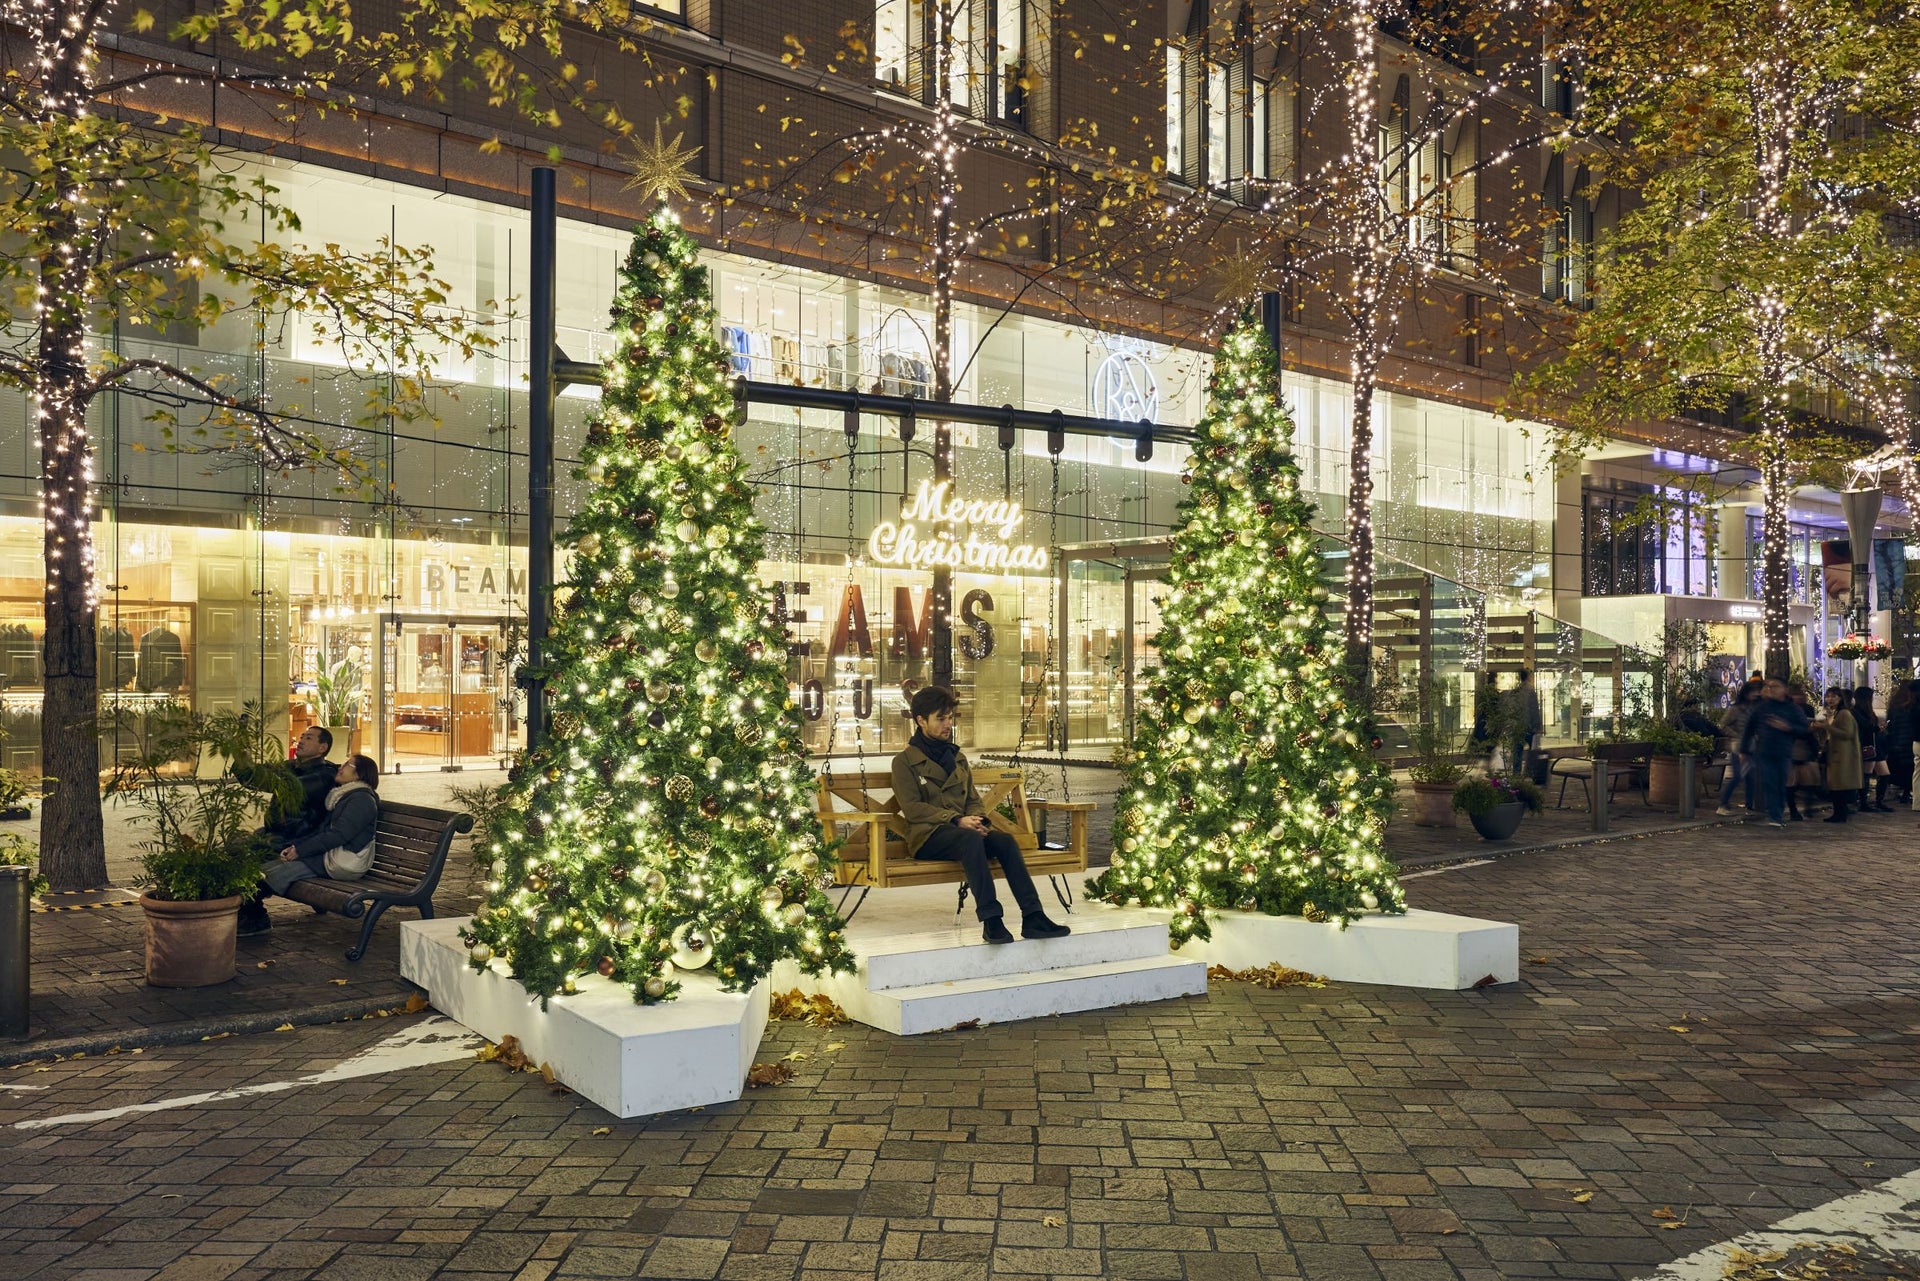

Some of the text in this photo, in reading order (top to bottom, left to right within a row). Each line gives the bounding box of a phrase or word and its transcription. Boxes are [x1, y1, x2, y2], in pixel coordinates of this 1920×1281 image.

[900, 479, 1024, 539] Merry
[868, 521, 1048, 569] Christmas
[427, 565, 526, 595] BEAM
[773, 581, 995, 660] EAMS
